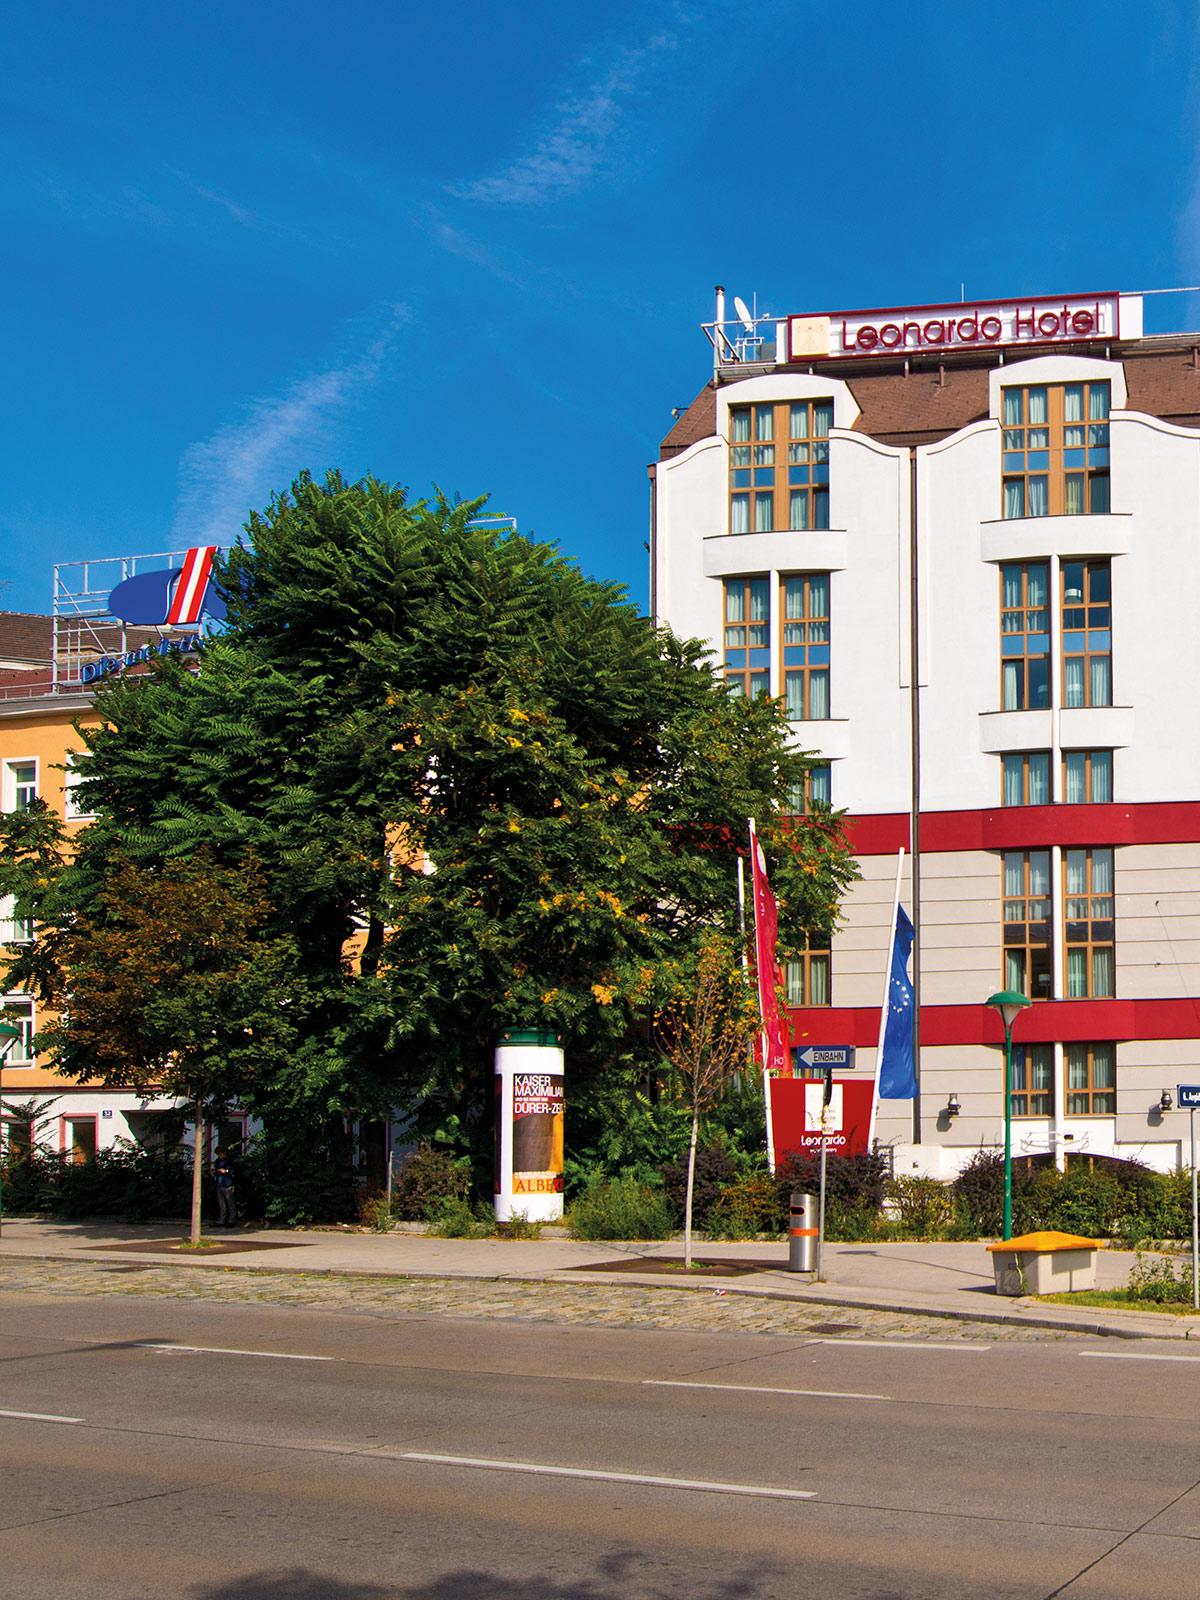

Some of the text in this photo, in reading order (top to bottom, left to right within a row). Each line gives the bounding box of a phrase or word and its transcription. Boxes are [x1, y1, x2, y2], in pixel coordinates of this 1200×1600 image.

[843, 302, 1100, 351] Leonardo Hotel
[813, 1052, 844, 1062] EINBAHN
[515, 1076, 551, 1086] KAISER
